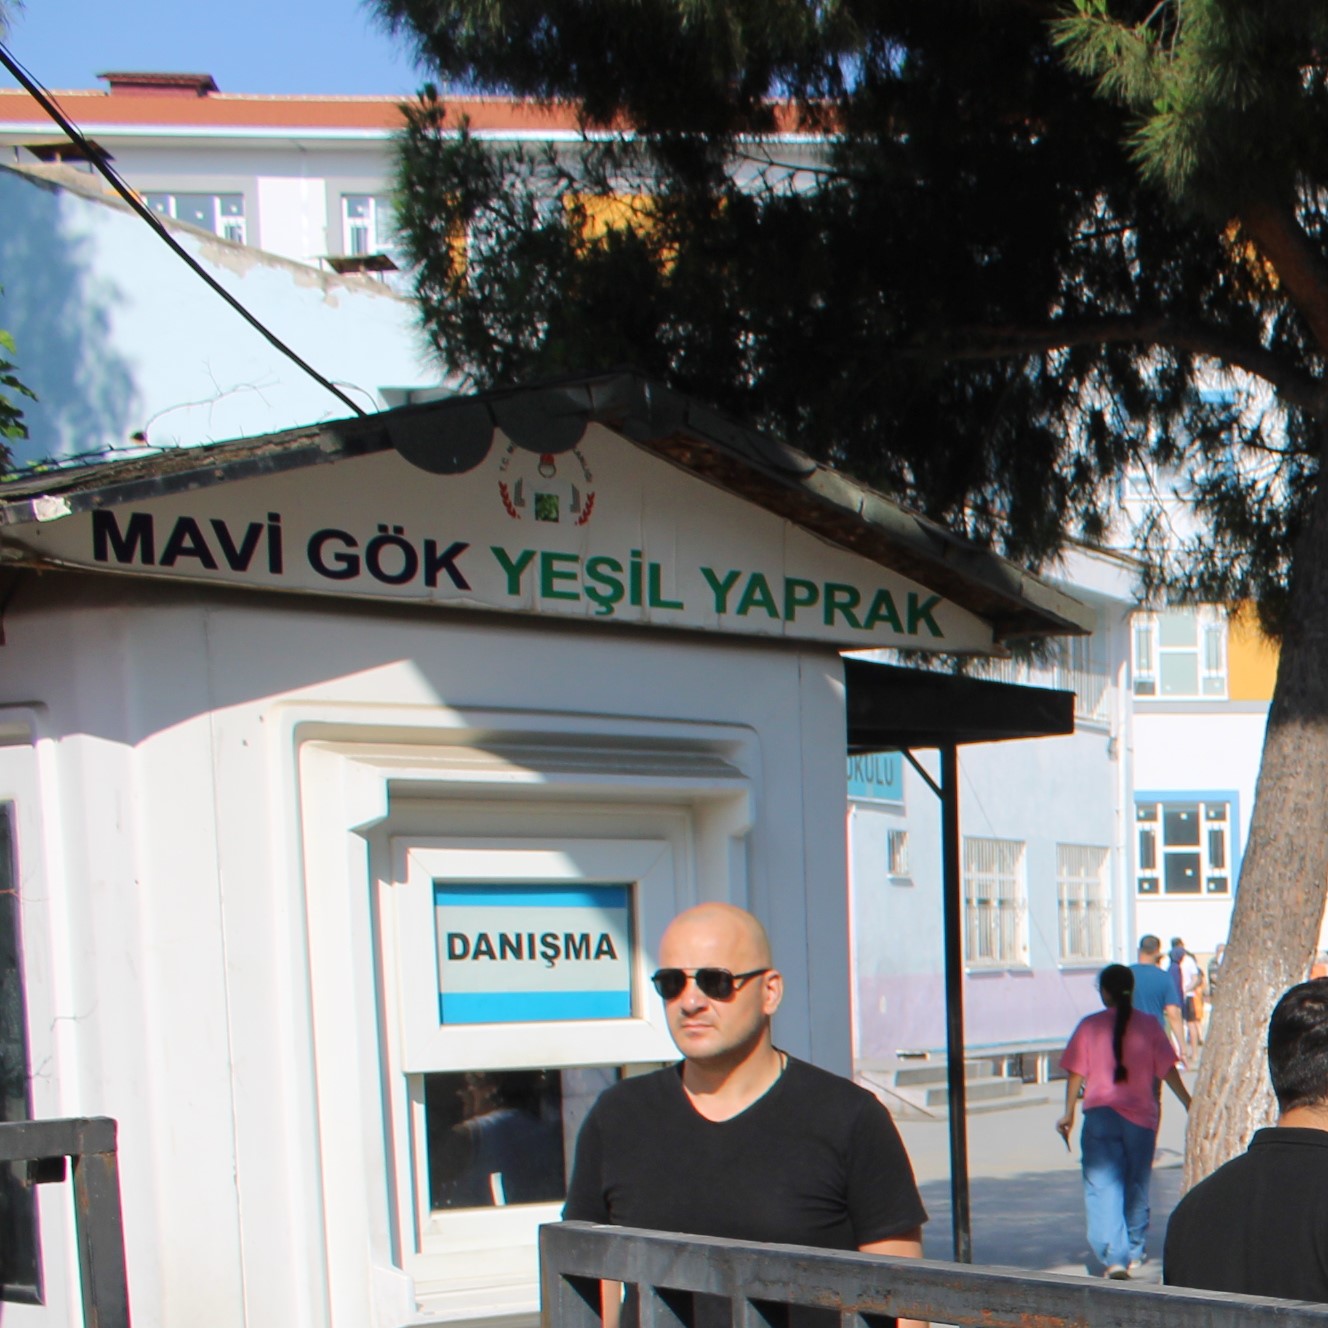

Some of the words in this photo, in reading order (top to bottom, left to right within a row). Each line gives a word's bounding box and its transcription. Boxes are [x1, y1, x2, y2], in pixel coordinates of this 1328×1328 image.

[92, 510, 284, 575] MAVİ
[307, 524, 472, 591] GÖK
[490, 546, 685, 615] YEŞİL
[700, 567, 945, 637] YAPRAK
[447, 932, 618, 968] DANIŞMA
